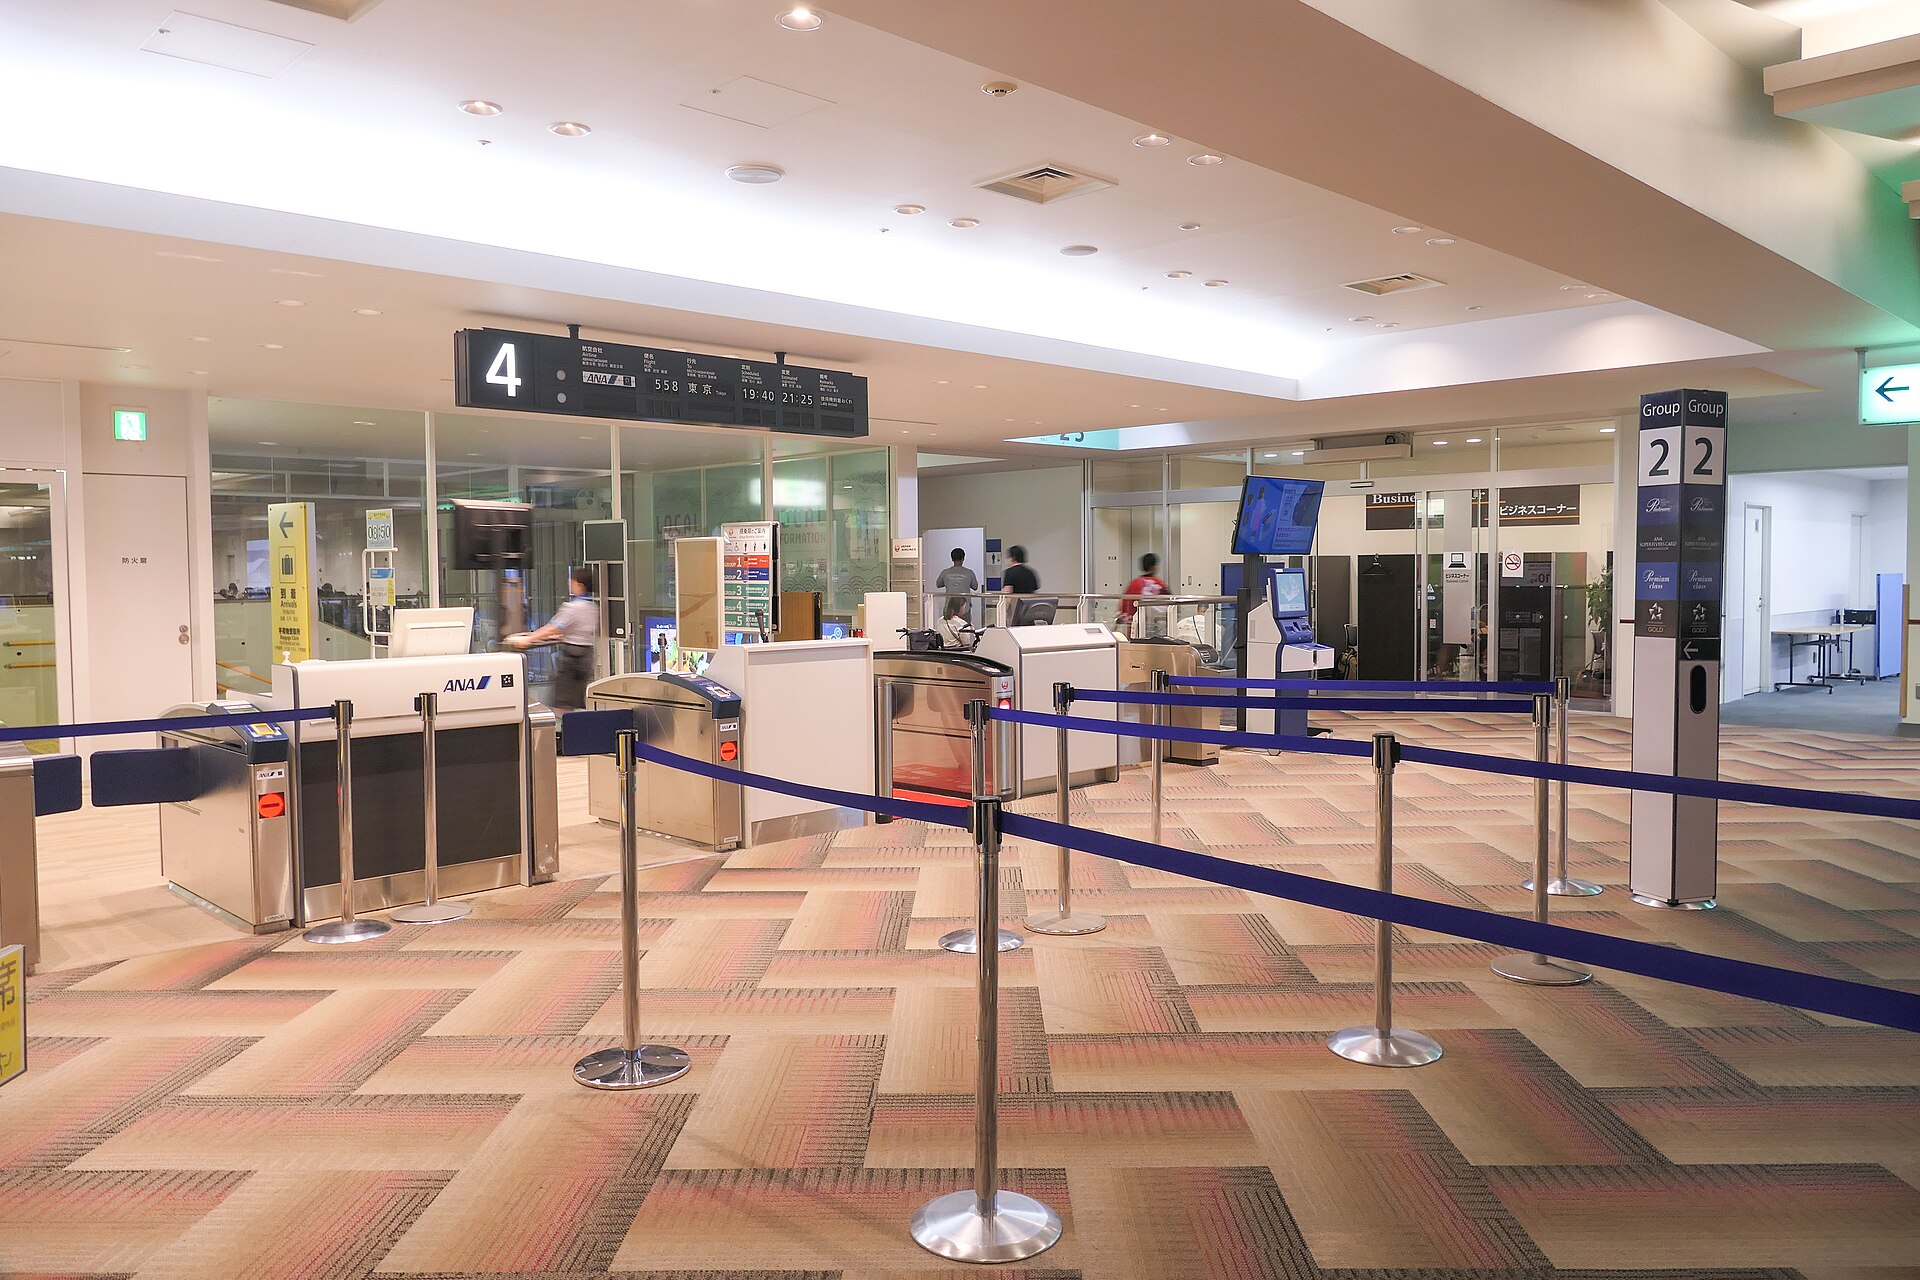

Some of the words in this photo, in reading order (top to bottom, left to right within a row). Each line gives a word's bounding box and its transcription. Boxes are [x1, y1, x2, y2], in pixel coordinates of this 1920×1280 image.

[486, 343, 522, 397] 4
[586, 374, 608, 384] ANA
[655, 379, 678, 392] 558
[688, 382, 712, 395] 東京
[743, 388, 775, 401] 19:40
[782, 392, 813, 405] 21:25
[1643, 403, 1680, 417] Group
[1688, 400, 1724, 417] Group
[1649, 438, 1670, 476] 2
[1693, 437, 1712, 475] 2
[1500, 504, 1576, 516] ビジネスコーナー
[780, 532, 826, 544] FORMATION
[737, 557, 742, 567] 1
[736, 570, 742, 580] 2
[1643, 569, 1670, 582] Premium
[736, 585, 742, 596] 3
[280, 600, 297, 608] Arrivals
[736, 600, 742, 611] 4
[737, 616, 743, 626] 5
[443, 679, 475, 692] ANA
